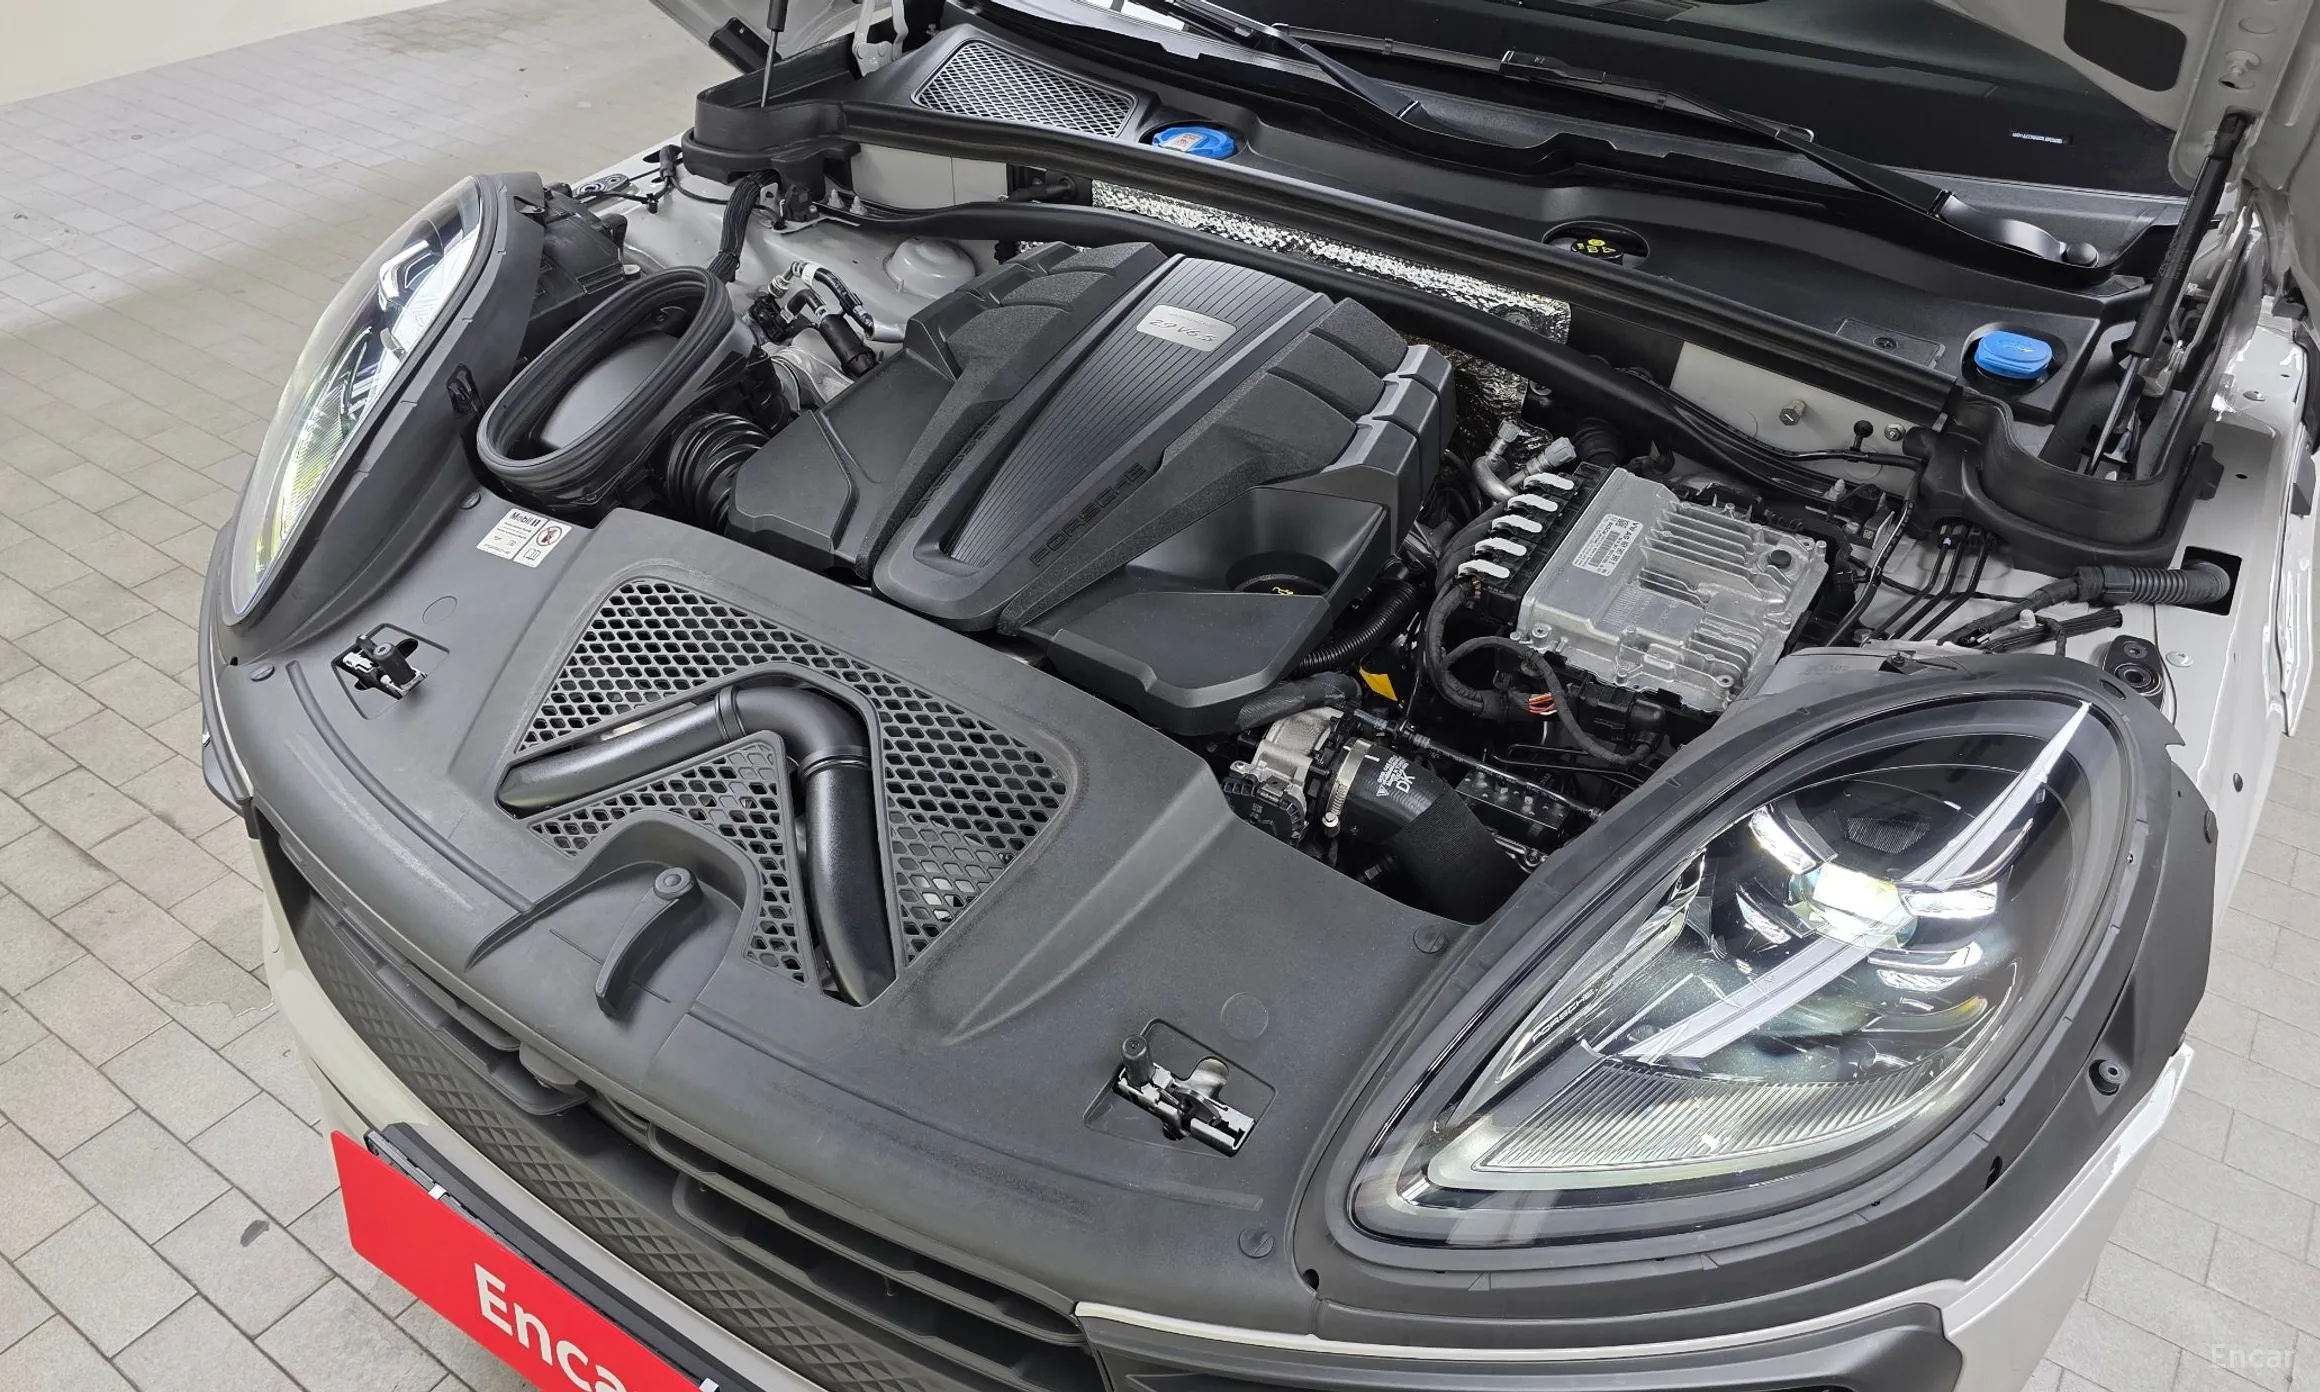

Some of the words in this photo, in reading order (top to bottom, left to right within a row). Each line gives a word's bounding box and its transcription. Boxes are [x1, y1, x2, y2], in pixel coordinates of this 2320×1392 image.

[511, 511, 533, 526] Mobil
[1029, 462, 1147, 567] PORSCHE
[1396, 770, 1416, 793] DK
[1532, 988, 1595, 1043] PORSCHE
